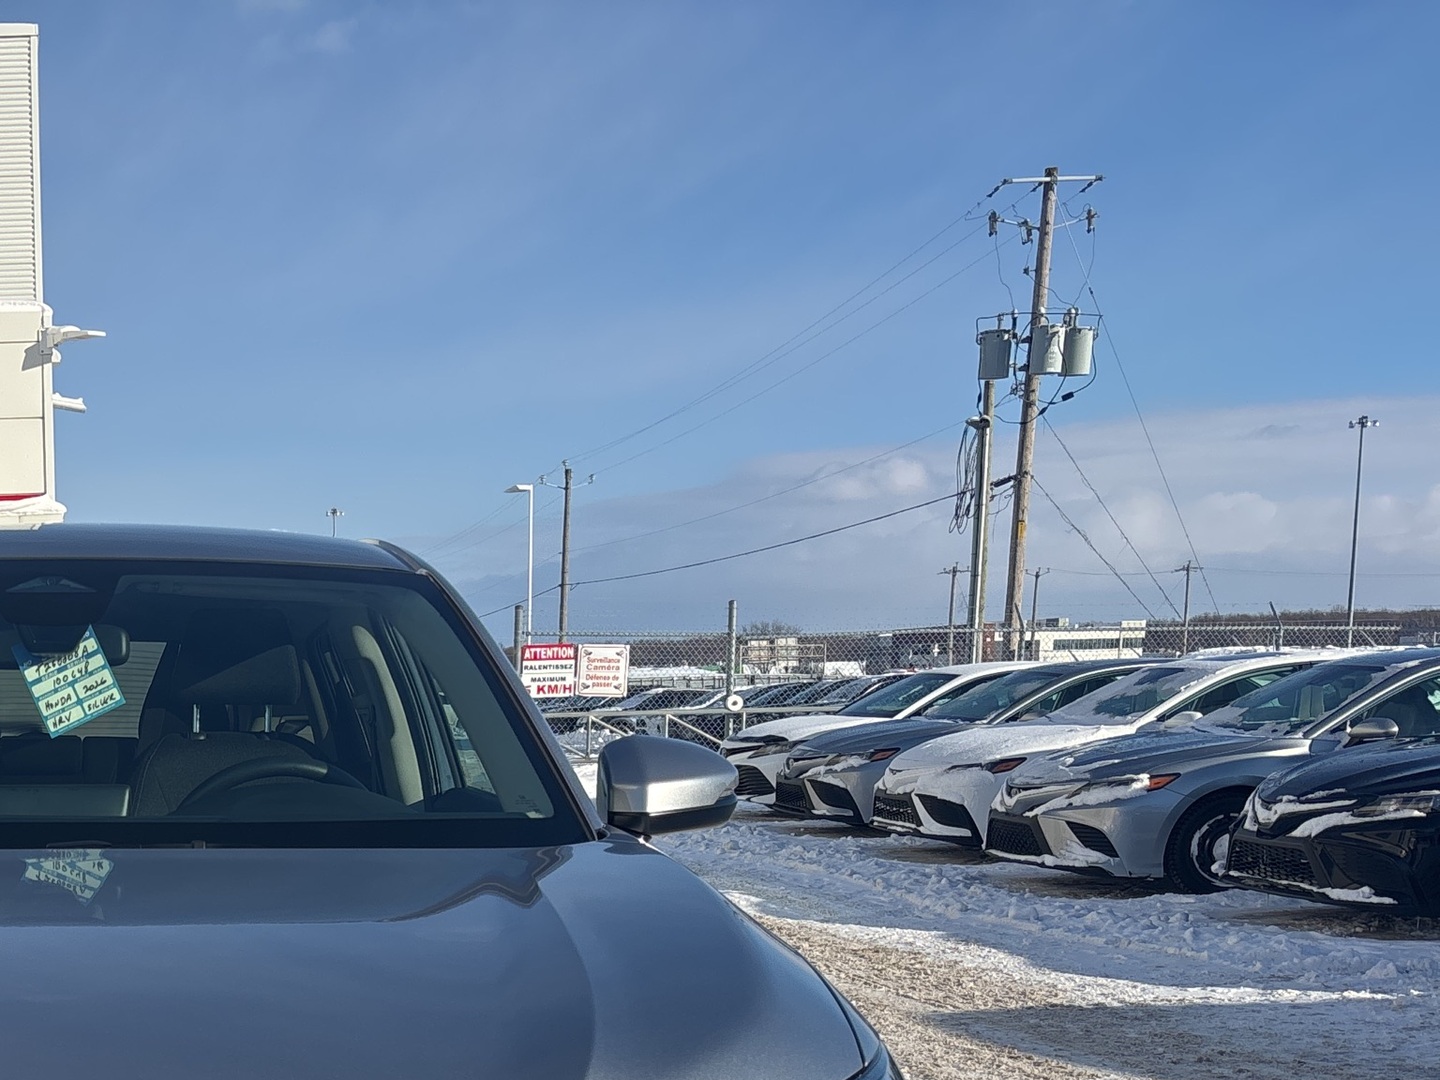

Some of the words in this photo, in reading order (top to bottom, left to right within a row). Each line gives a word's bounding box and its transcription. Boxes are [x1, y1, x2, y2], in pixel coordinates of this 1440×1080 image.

[524, 647, 574, 660] ATTENTION
[536, 684, 573, 695] KM/H
[591, 681, 613, 689] passer
[52, 711, 72, 729] HRV
